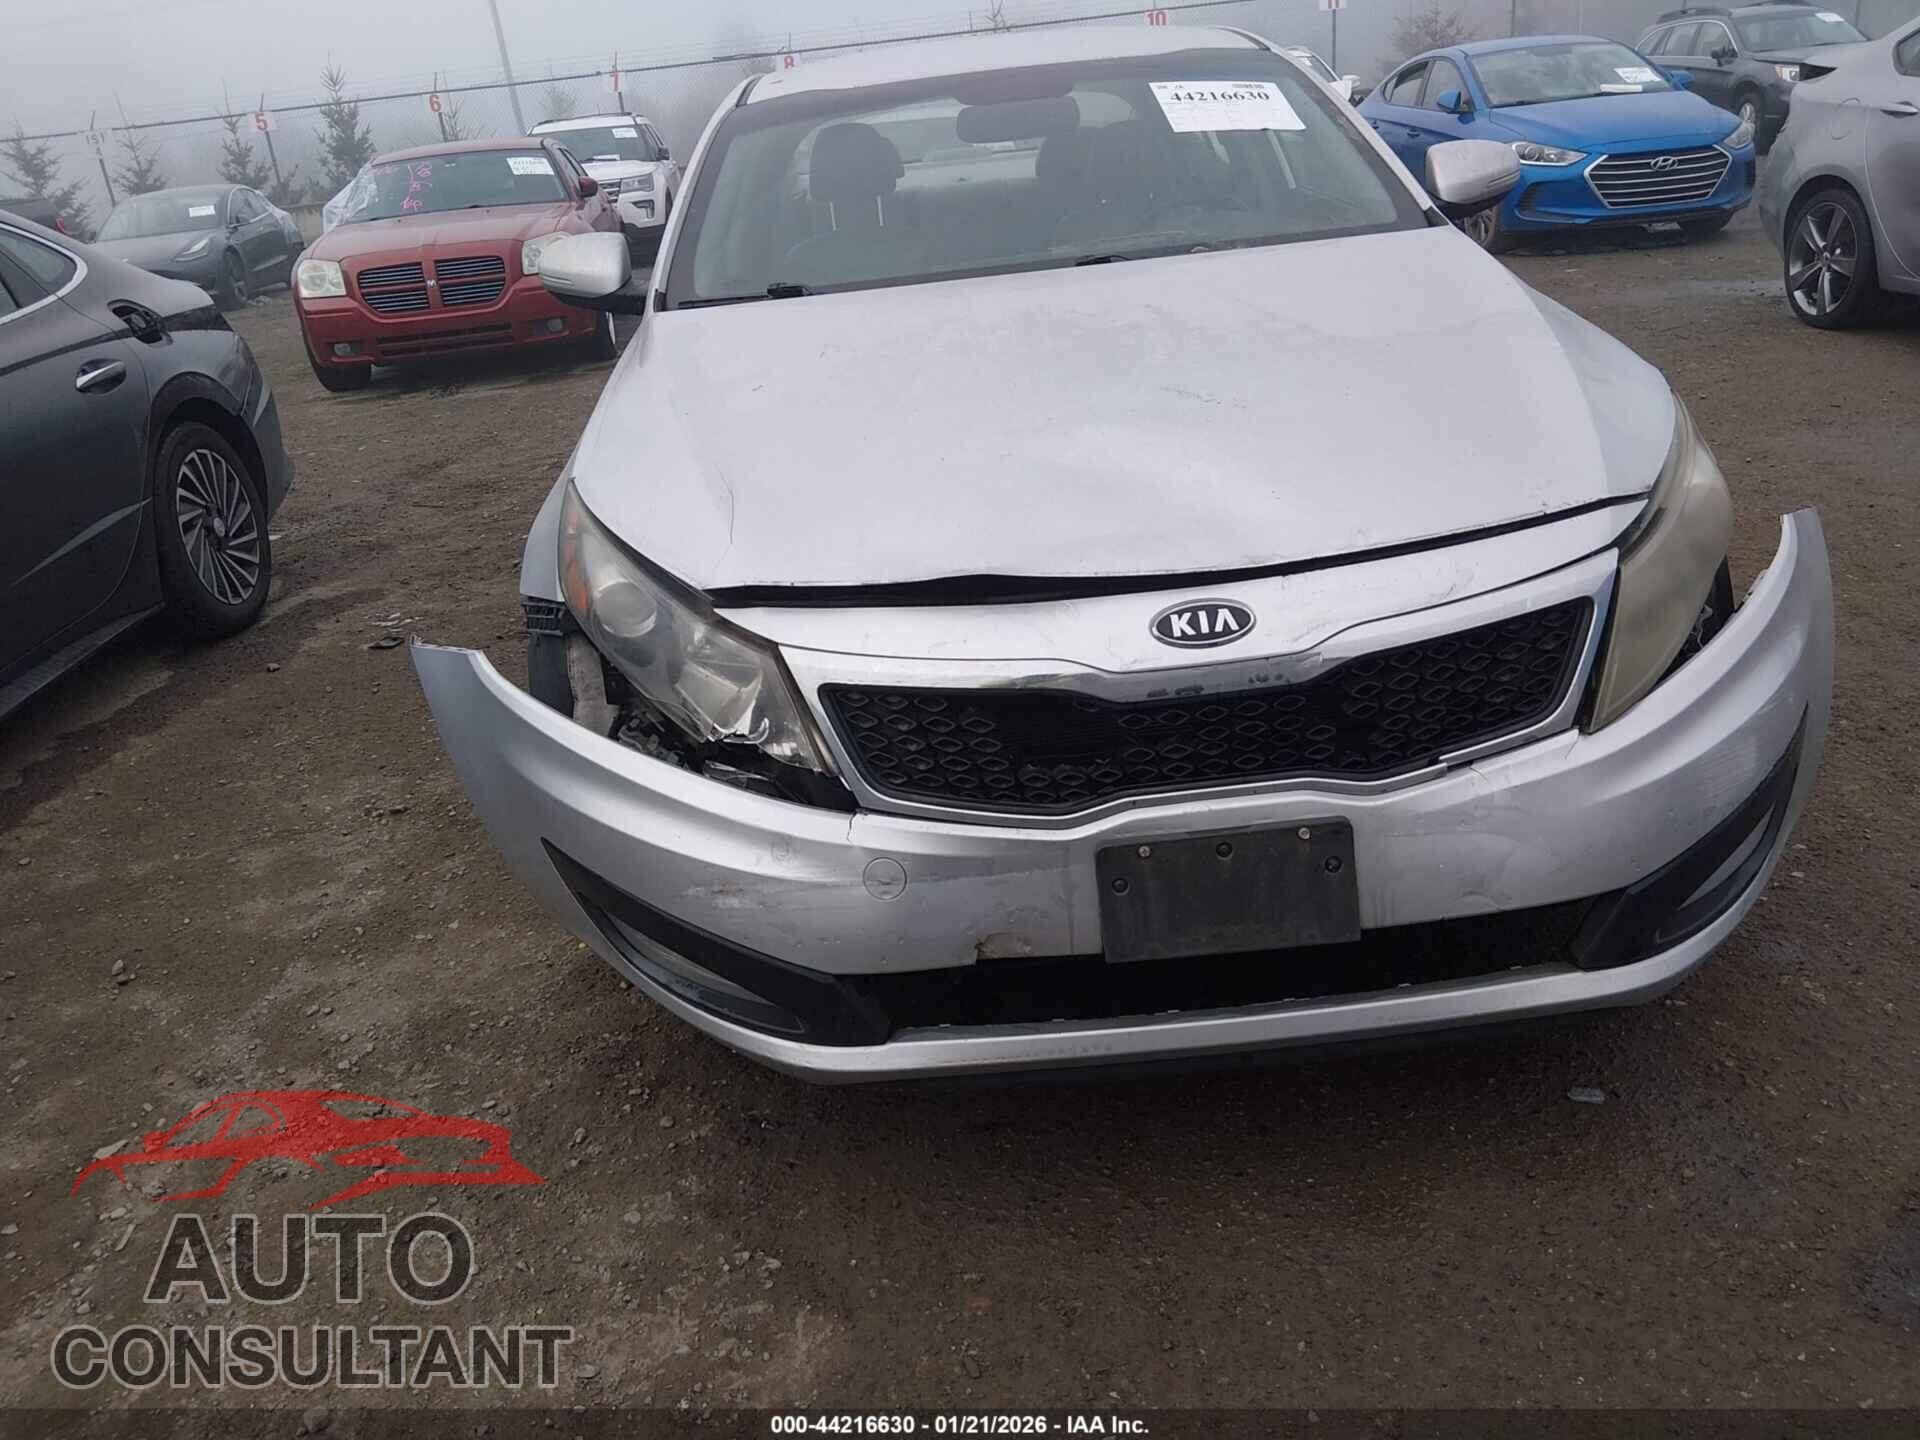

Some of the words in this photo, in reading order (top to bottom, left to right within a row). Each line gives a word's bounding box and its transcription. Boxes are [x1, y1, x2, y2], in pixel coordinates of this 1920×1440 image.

[429, 94, 442, 113] 6
[1170, 90, 1270, 102] 44216630
[254, 112, 268, 132] 5
[1169, 608, 1240, 638] KIA
